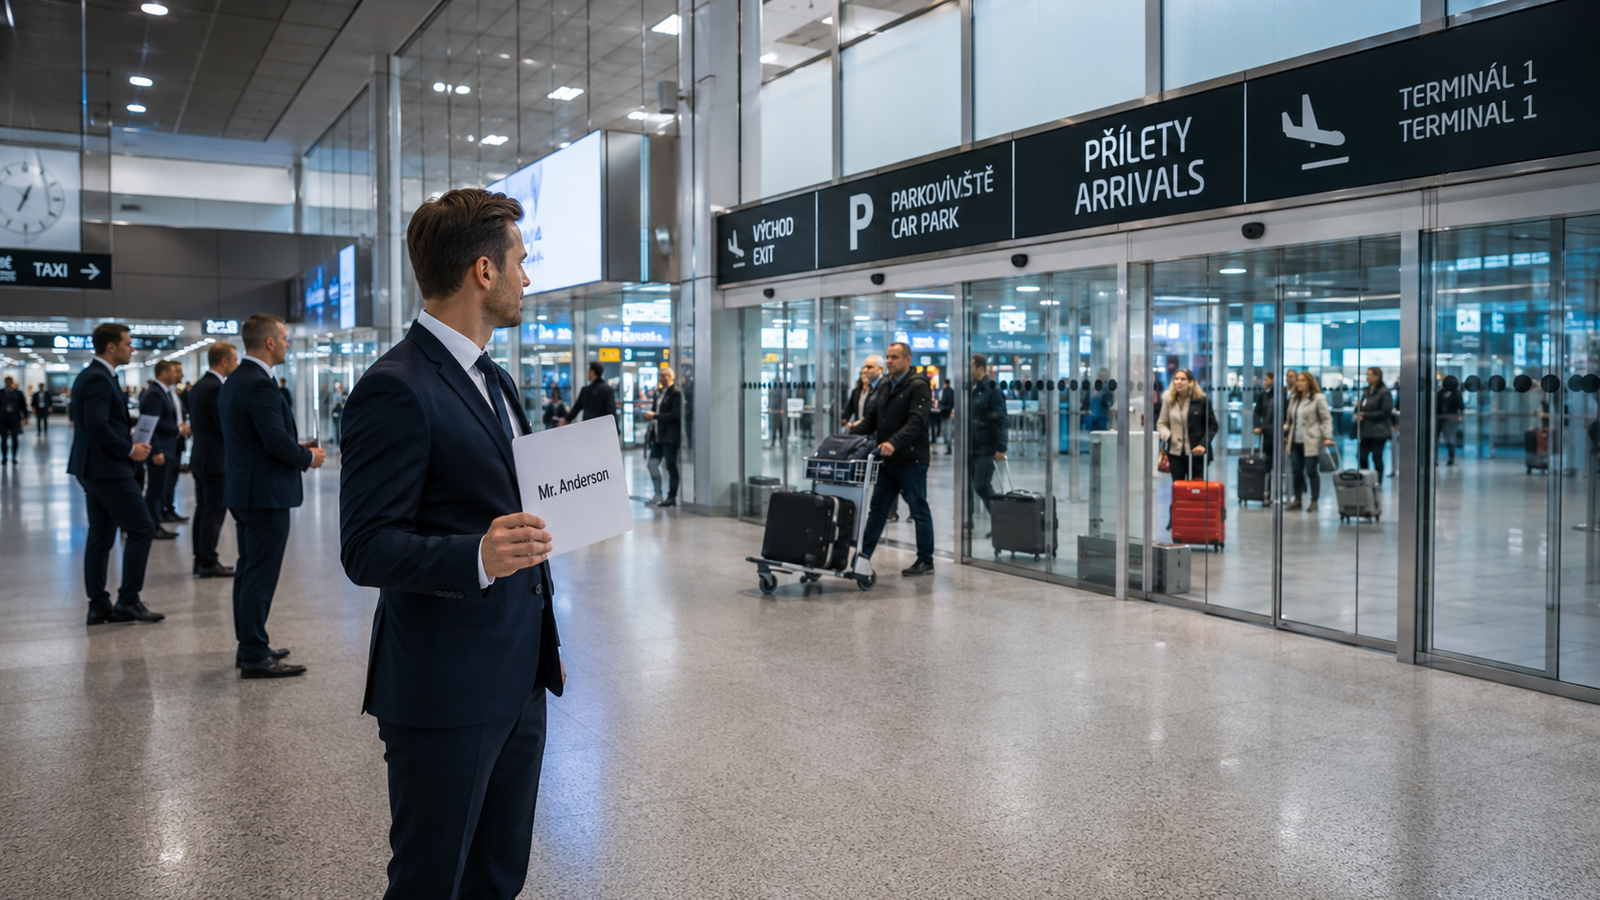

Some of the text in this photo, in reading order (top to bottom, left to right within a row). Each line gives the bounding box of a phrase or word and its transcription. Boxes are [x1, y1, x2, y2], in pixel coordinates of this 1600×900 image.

[1399, 59, 1537, 111] TERMINÁL 1
[1399, 94, 1537, 143] TERMINAL 1
[1084, 116, 1192, 173] PŘÍLETY
[1074, 159, 1205, 215] ARRIVALS
[752, 216, 794, 243] VÝCHOD
[849, 192, 874, 251] P
[891, 206, 960, 239] CAR PARK
[32, 261, 69, 278] TAXI
[753, 244, 775, 266] EXIT
[538, 469, 610, 501] Mr. Anderson
